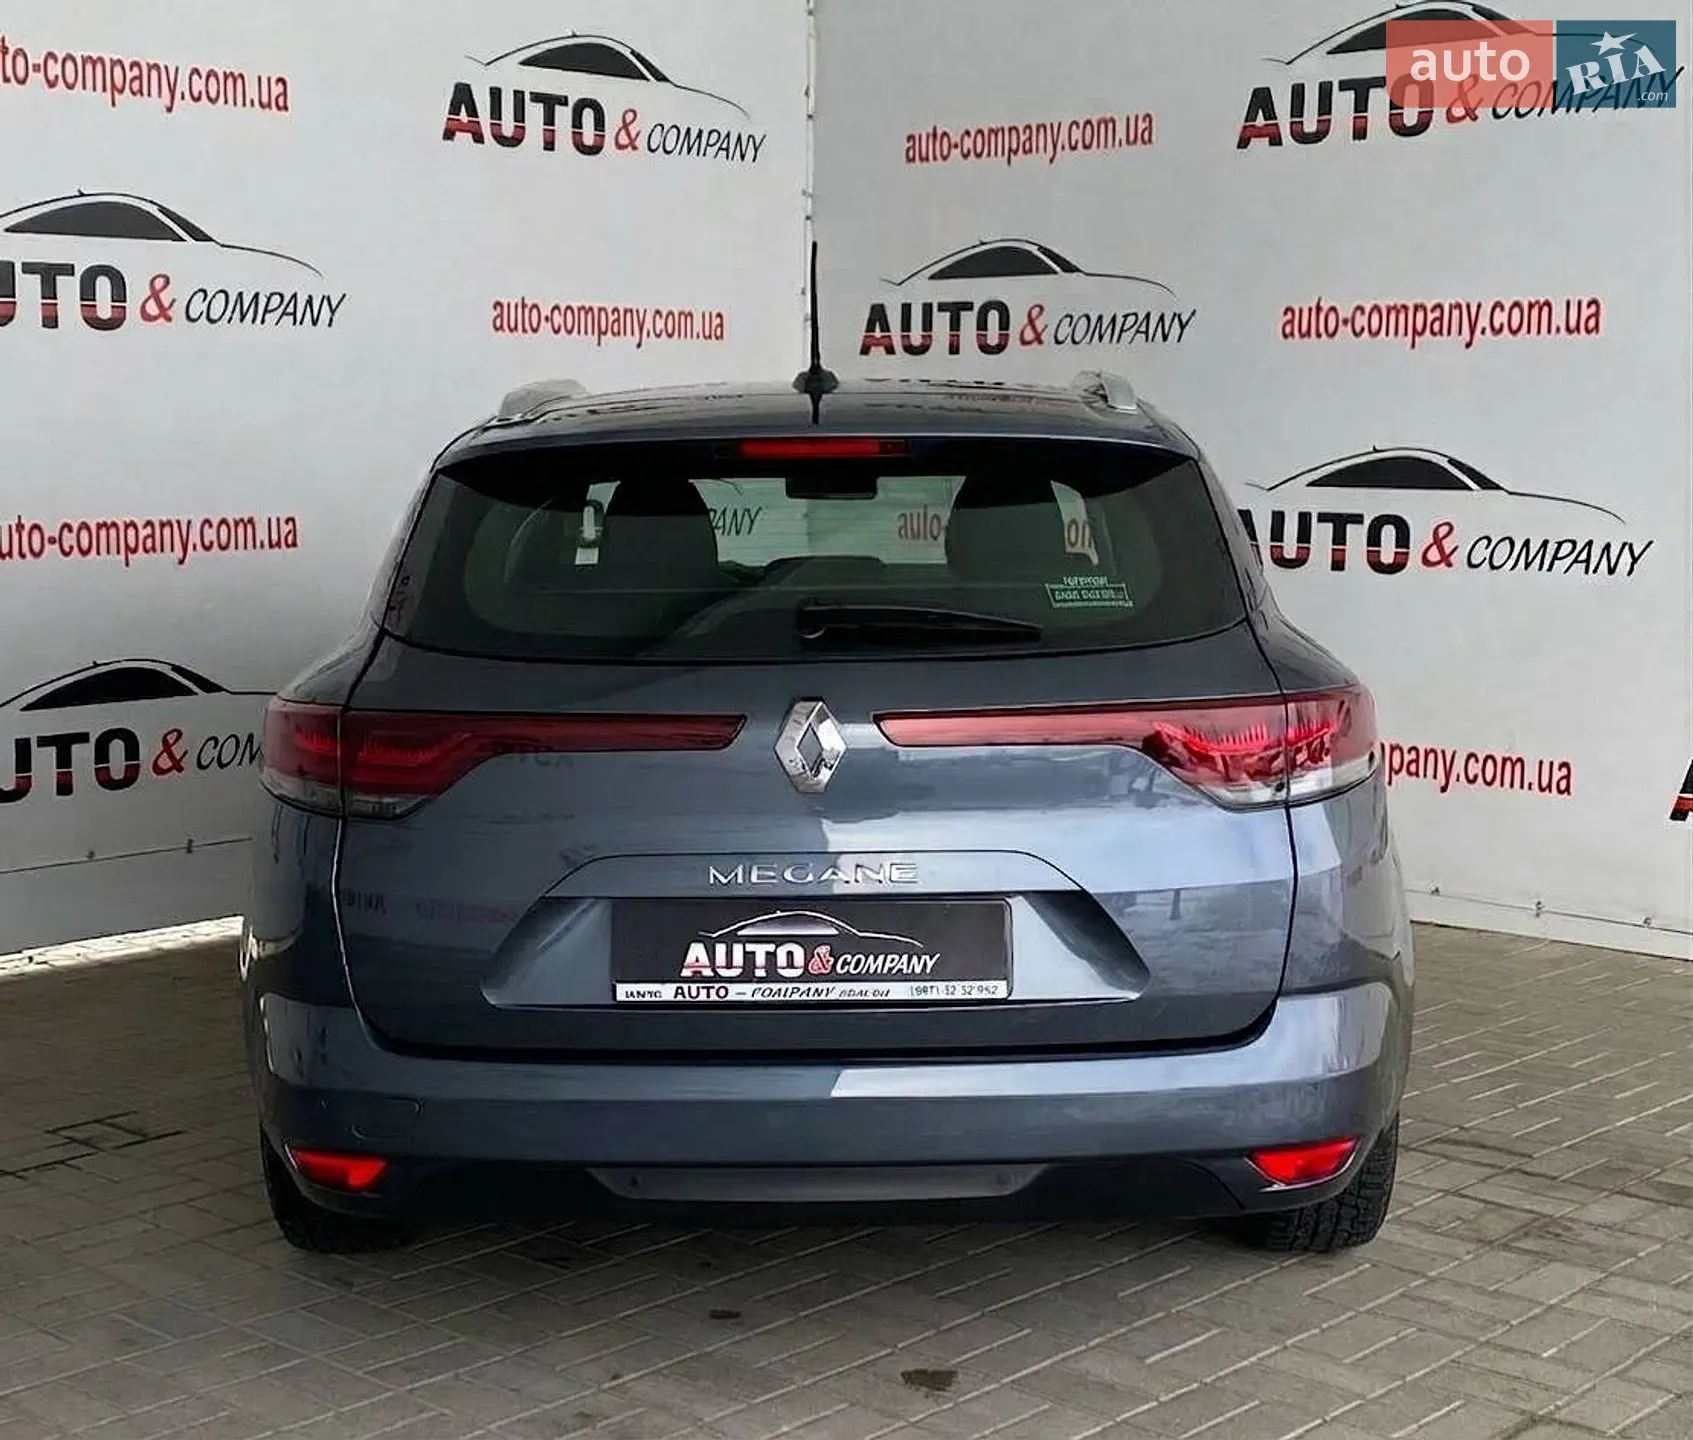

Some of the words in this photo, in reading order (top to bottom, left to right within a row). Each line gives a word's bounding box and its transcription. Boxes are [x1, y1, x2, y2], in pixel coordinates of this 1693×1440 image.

[442, 82, 606, 156] AUTO
[614, 108, 642, 151] &
[646, 123, 766, 163] COMPANY
[1236, 71, 1435, 149] AUTO
[905, 112, 1154, 166] auto-company.com.ua
[140, 273, 177, 323] &
[185, 289, 347, 328] COMPANY
[492, 296, 725, 348] auto-company.com.ua
[859, 299, 1011, 356] AUTO
[1019, 304, 1049, 346] &
[1053, 309, 1197, 346] COMPANY
[1281, 297, 1601, 348] auto-company.com.ua
[1421, 521, 1460, 568] &
[1466, 535, 1653, 576] COMPANY
[152, 728, 188, 776] &
[1380, 741, 1572, 796] pany.com.ua
[681, 942, 805, 978] AUTO
[808, 945, 834, 975] &
[836, 953, 940, 976] COMPANY
[673, 985, 729, 999] AUTO
